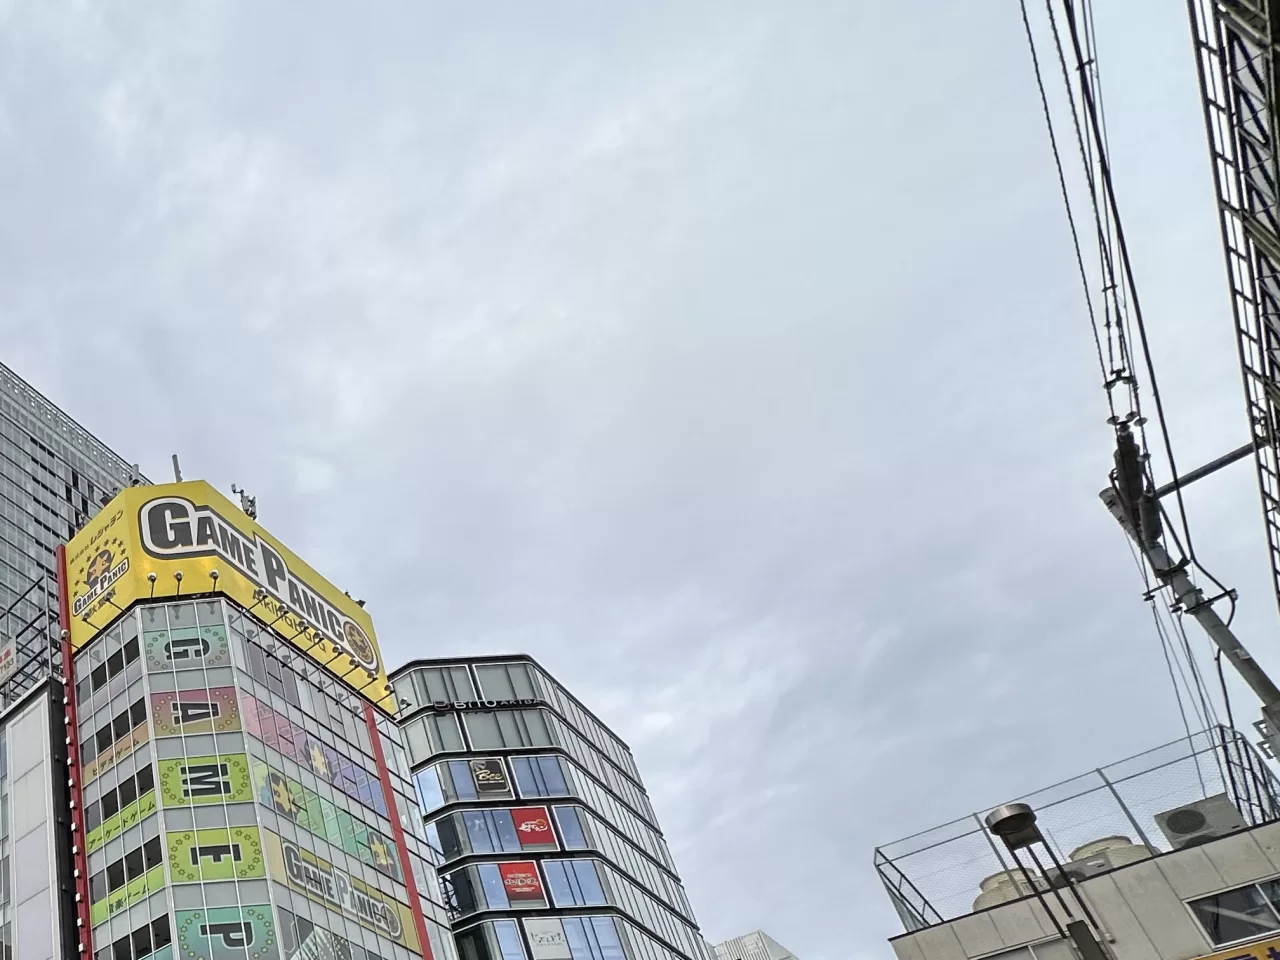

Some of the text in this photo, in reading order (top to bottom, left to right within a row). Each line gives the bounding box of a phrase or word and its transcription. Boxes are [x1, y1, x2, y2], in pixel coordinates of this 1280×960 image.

[73, 561, 128, 614] GAME PANIC
[147, 501, 346, 642] GAME PANIC
[88, 801, 156, 849] アーケードゲーム
